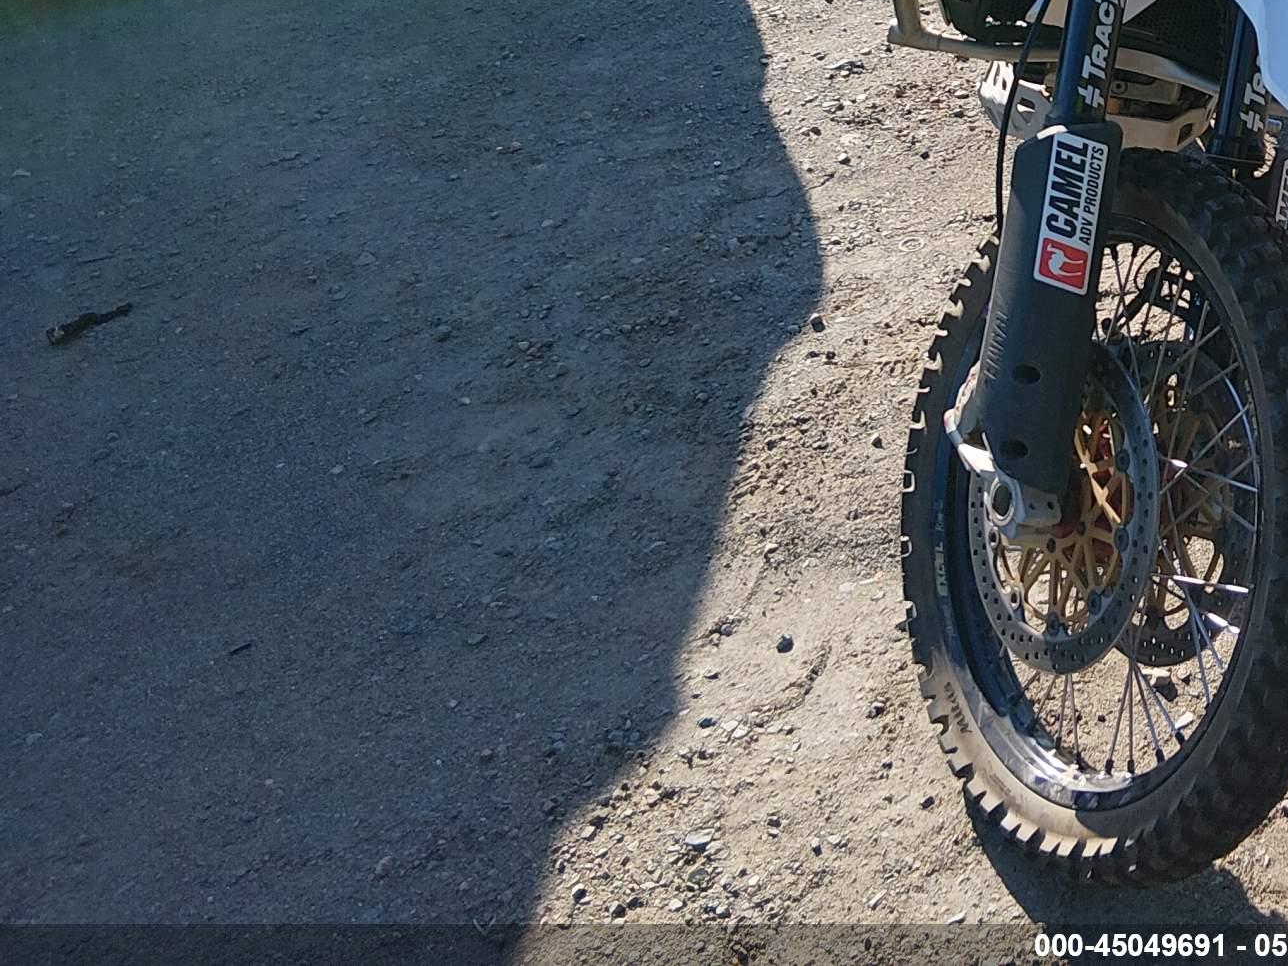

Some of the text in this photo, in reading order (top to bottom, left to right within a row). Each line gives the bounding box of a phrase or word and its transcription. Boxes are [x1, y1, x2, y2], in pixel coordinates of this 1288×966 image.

[1046, 140, 1090, 240] CAMEL
[1078, 145, 1105, 246] ADV PRODUCTS
